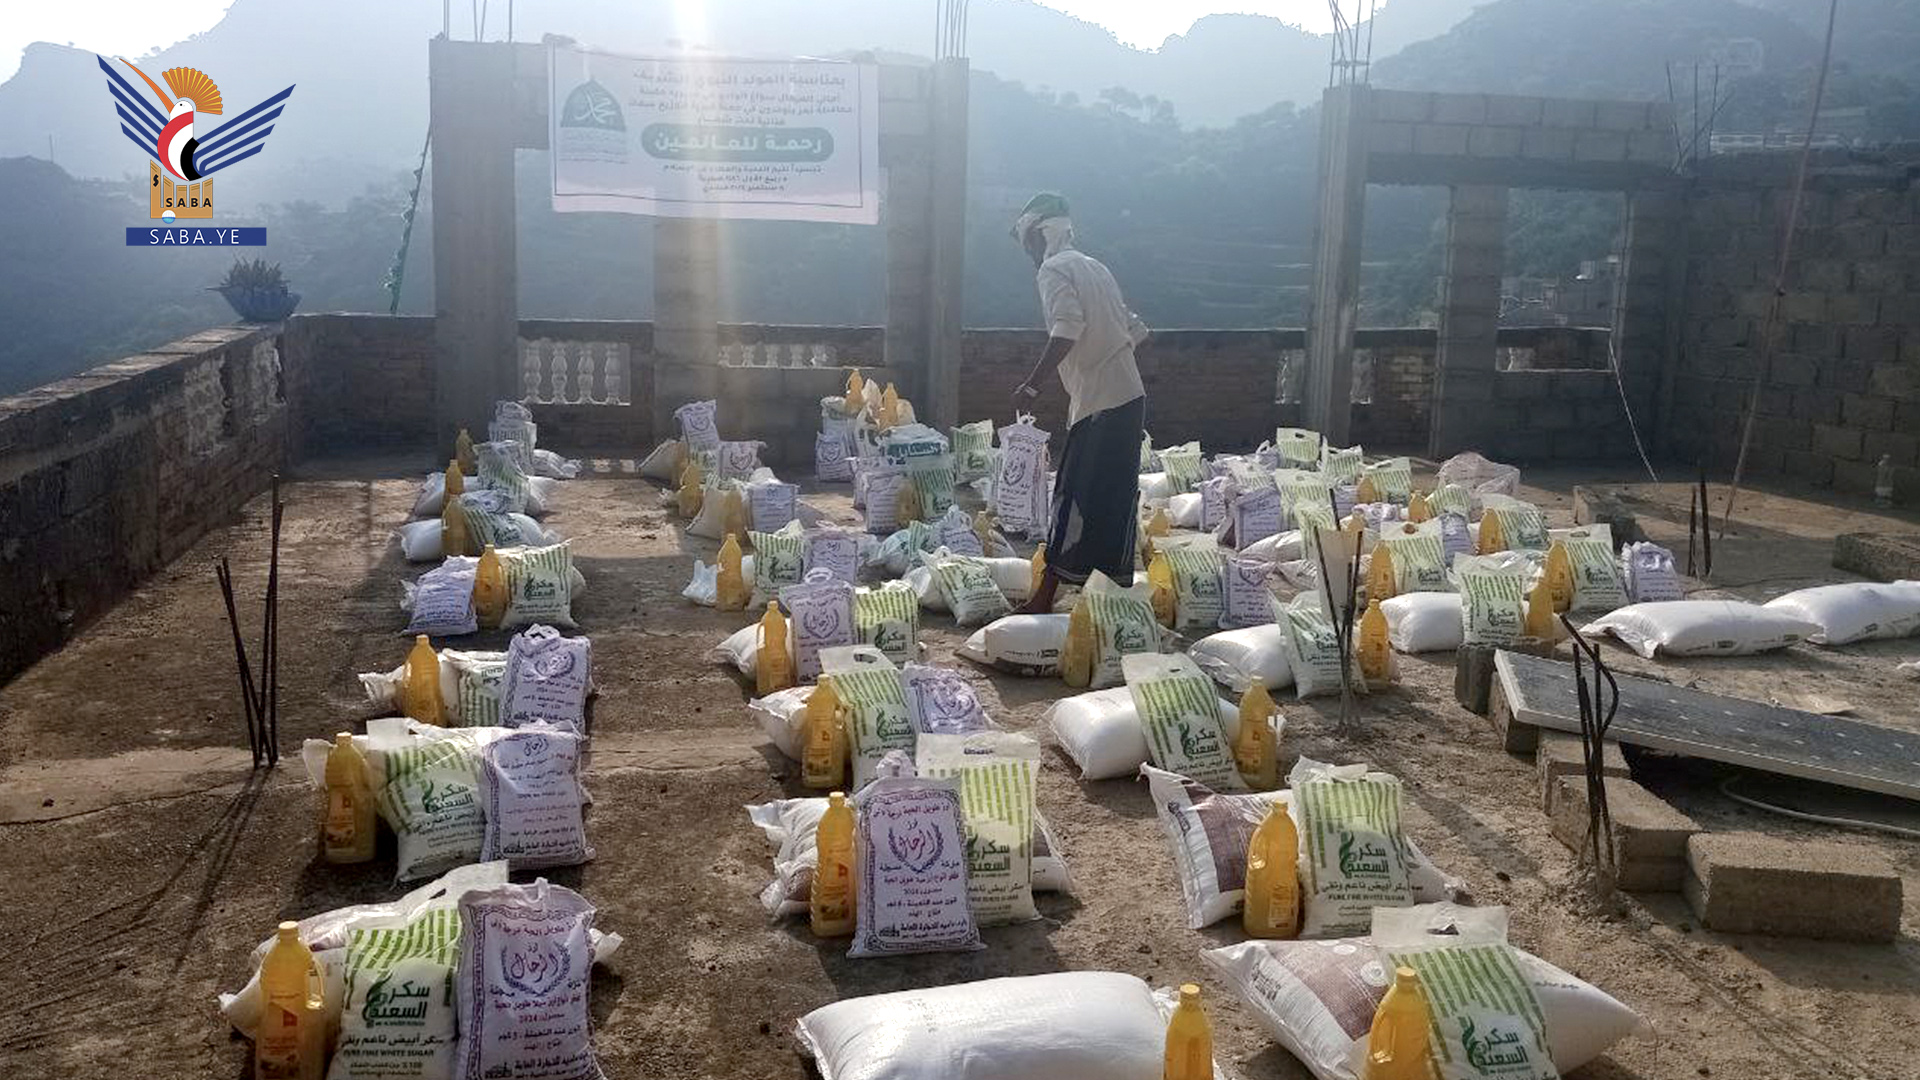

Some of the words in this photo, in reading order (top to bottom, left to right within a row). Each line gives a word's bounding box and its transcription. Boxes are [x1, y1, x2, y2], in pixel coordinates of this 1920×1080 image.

[654, 131, 757, 153] للعالمين
[765, 133, 822, 154] رحمة
[981, 839, 1010, 860] سكر
[1359, 842, 1387, 862] سكر
[1347, 859, 1389, 873] السعيد
[389, 980, 431, 1004] سكر
[369, 1001, 428, 1019] السعيد
[1484, 1027, 1520, 1052] سكر
[1478, 1045, 1529, 1067] السعيد
